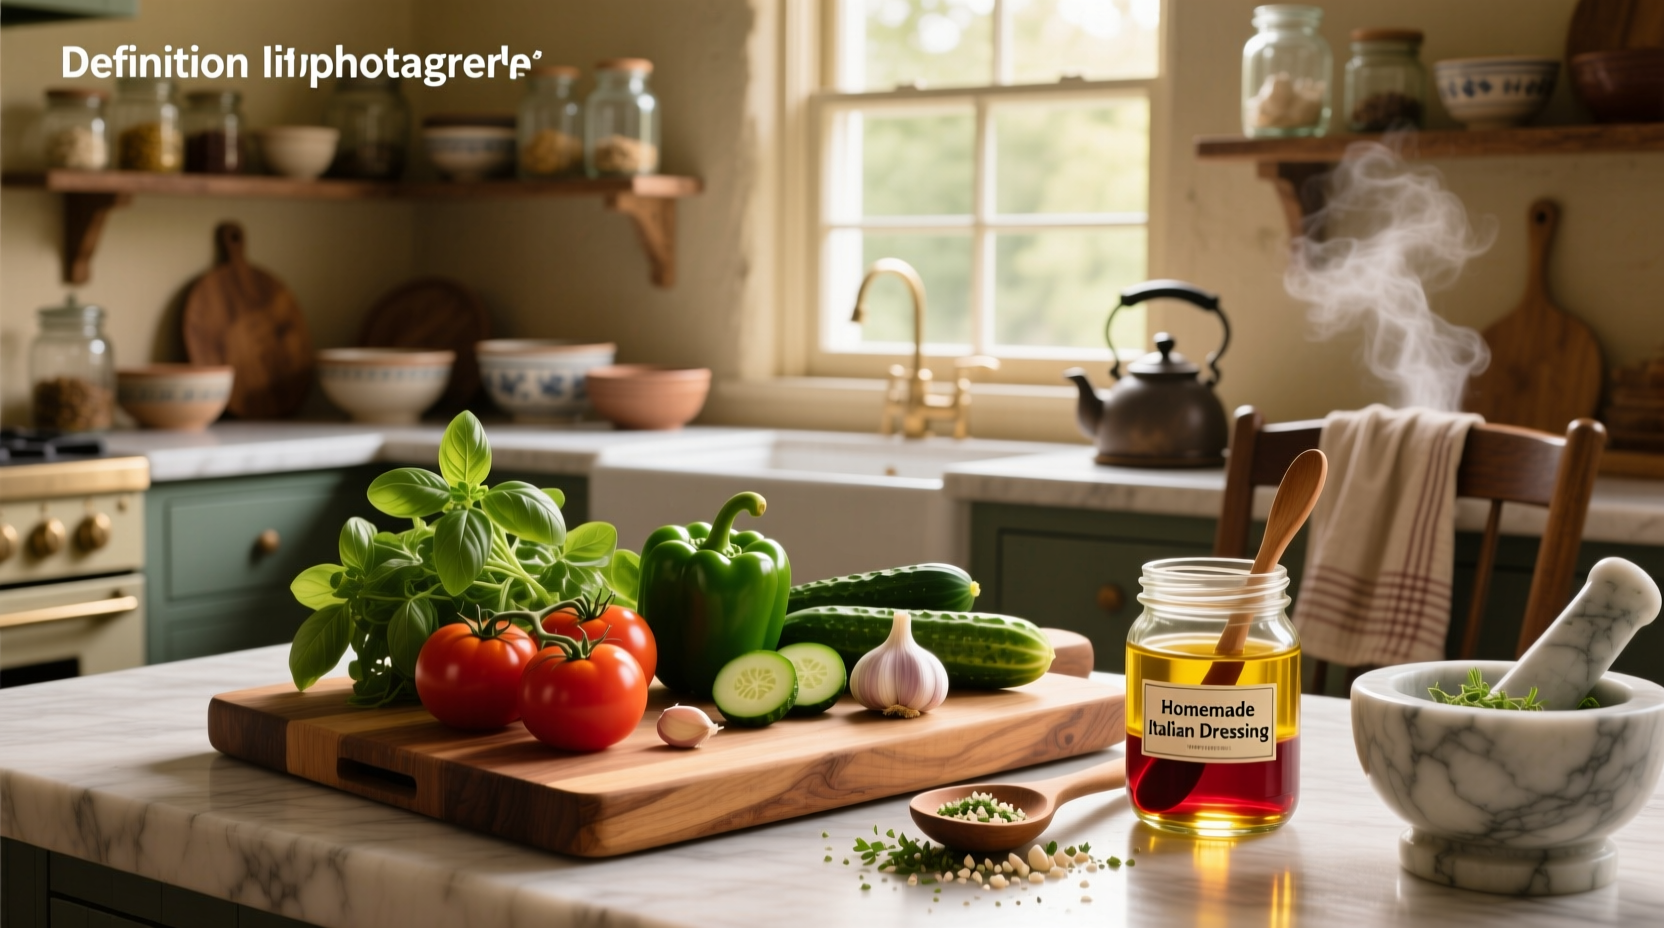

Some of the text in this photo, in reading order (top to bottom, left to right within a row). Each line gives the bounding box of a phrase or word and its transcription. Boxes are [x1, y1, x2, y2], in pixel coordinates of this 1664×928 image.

[1161, 699, 1255, 718] Homemade
[1148, 719, 1270, 743] Italian Dressing
